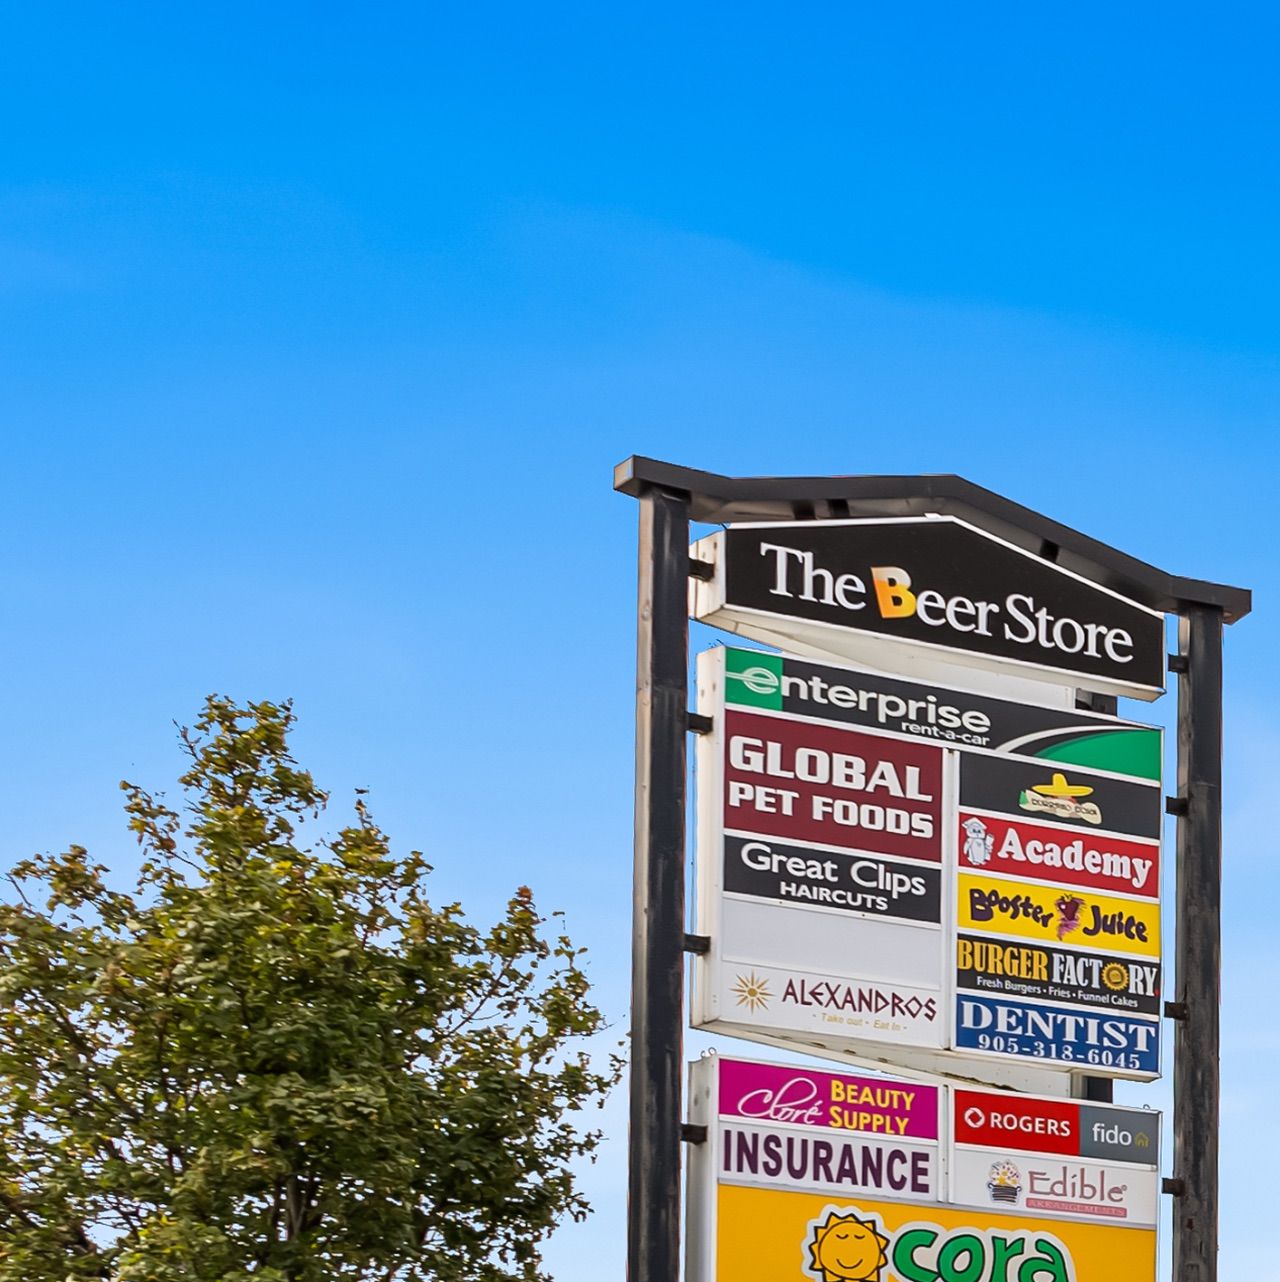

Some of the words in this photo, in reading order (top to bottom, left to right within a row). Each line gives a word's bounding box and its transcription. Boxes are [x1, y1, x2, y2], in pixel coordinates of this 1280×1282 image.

[760, 542, 866, 610] The
[871, 566, 1000, 638] Beer
[1002, 593, 1134, 663] Store
[738, 666, 992, 734] enterprise
[901, 718, 991, 748] rent-a-car
[729, 735, 933, 802] GLOBAL
[728, 781, 799, 816] PET
[812, 795, 934, 838] FOODS
[740, 842, 838, 882] Great
[850, 860, 927, 899] Clips
[997, 827, 1153, 888] Academy
[780, 881, 888, 910] HAIRCUTS
[969, 888, 1054, 929] Booster
[1082, 905, 1149, 943] Juice
[957, 938, 1049, 982] BURGER
[782, 978, 937, 1021] ALEXANDROS
[976, 976, 1003, 989] Fresh
[1004, 981, 1041, 995] Burgers
[1048, 986, 1071, 999] Fries
[1077, 990, 1110, 1003] Funnel
[1111, 995, 1138, 1008] Cakes
[961, 1000, 1155, 1052] DENTIST
[978, 1033, 1141, 1069] 905-318-6045
[737, 1077, 823, 1125] Cloré
[831, 1080, 915, 1111] BEAUTY
[829, 1106, 909, 1135] SUPPLY
[989, 1113, 1071, 1137] ROGERS
[1092, 1123, 1132, 1147] fido
[723, 1130, 930, 1194] INSURANCE
